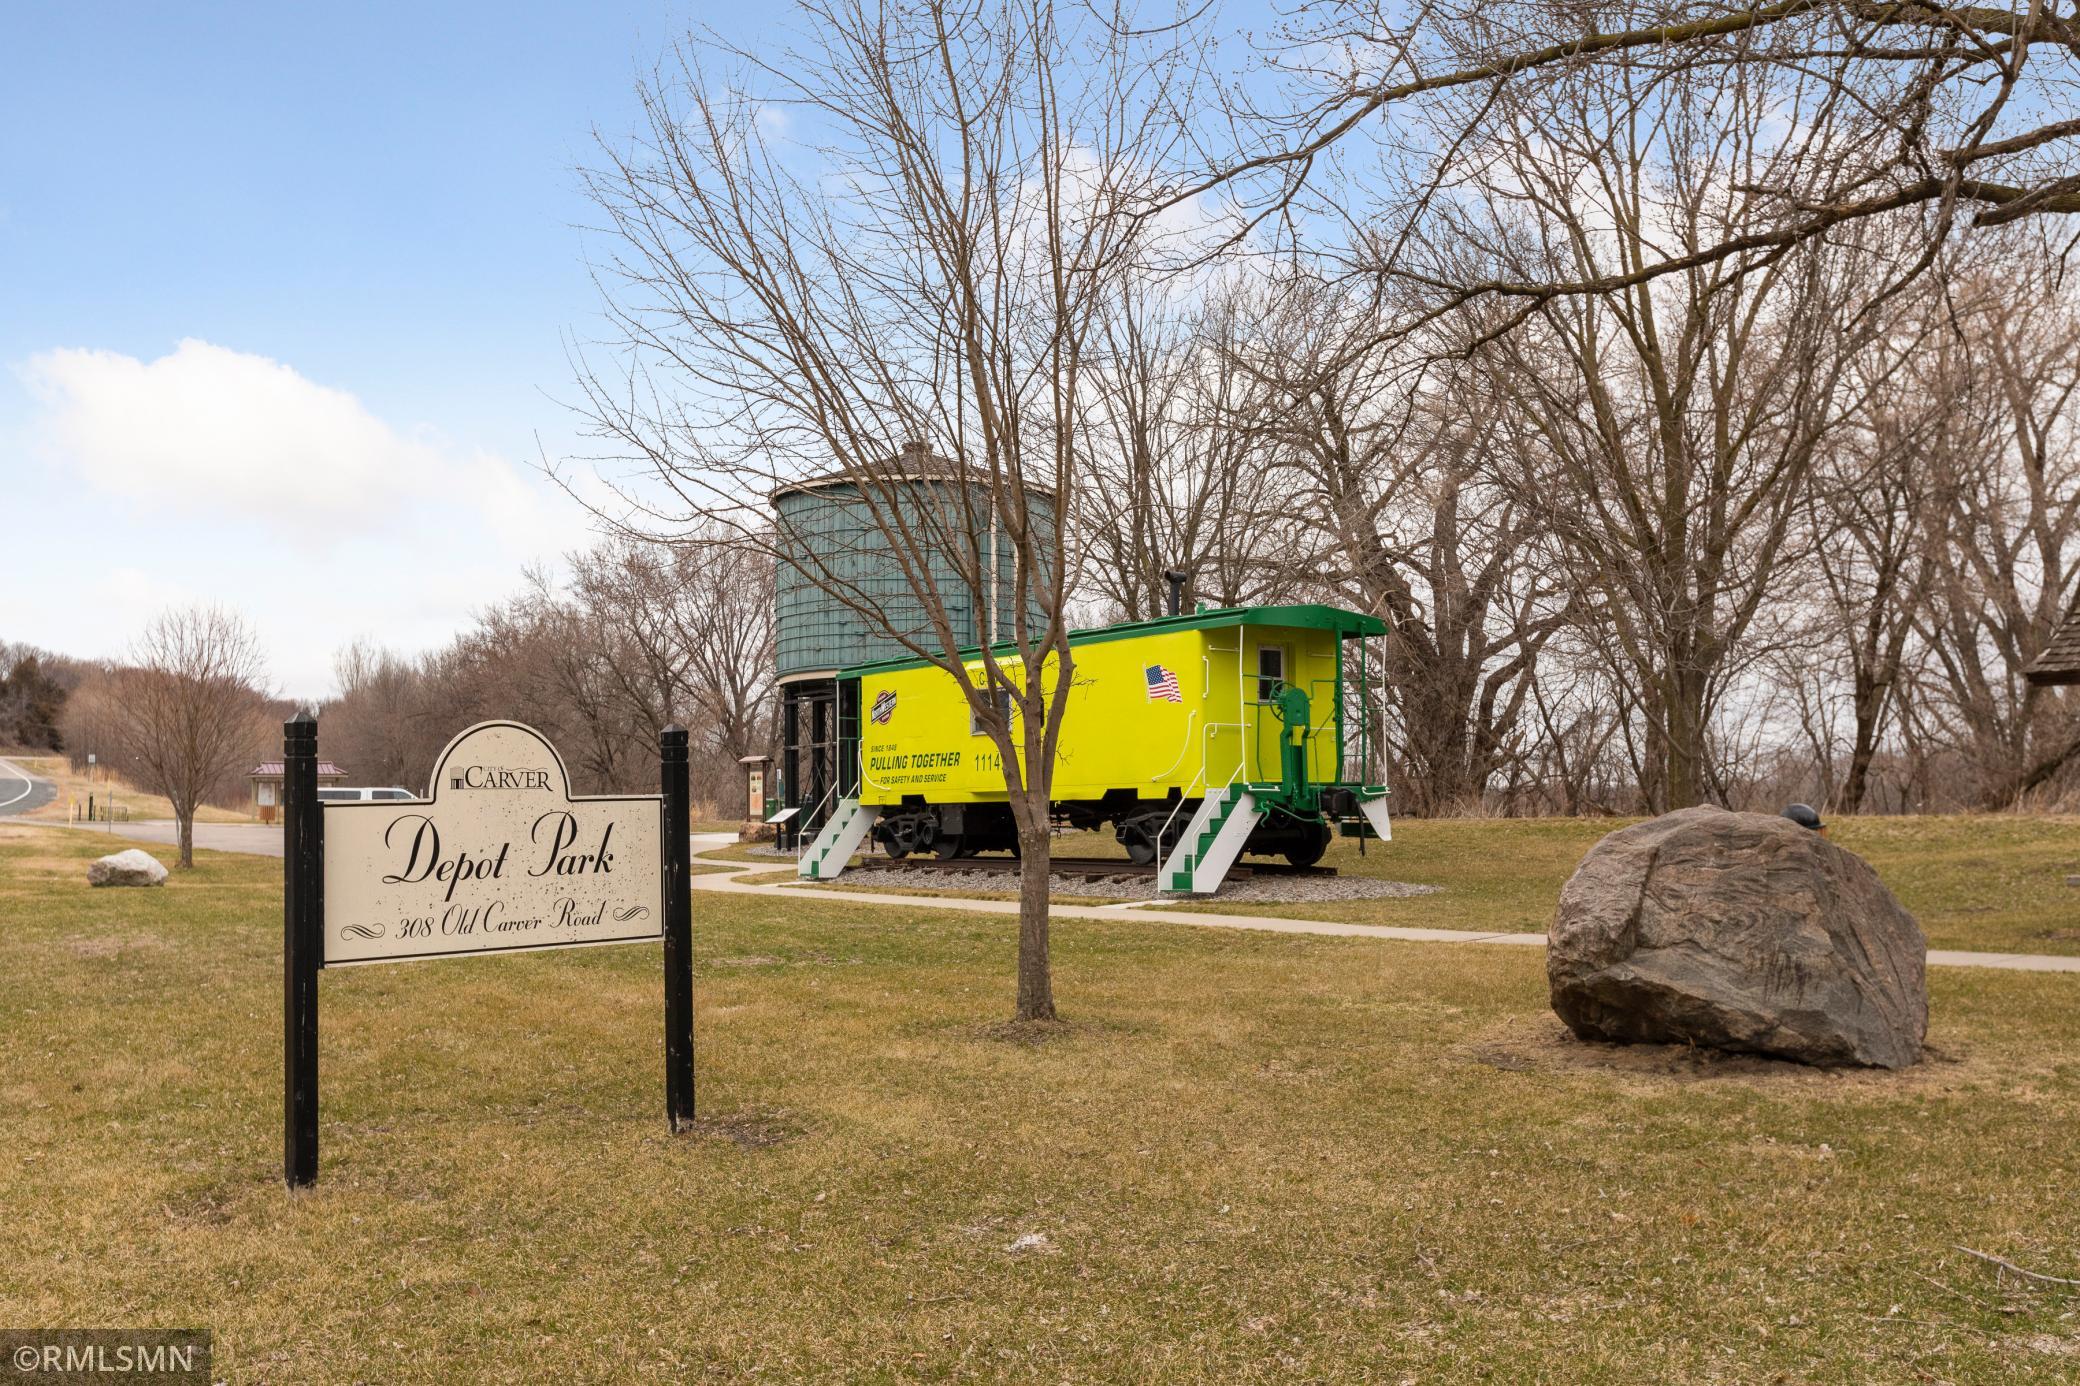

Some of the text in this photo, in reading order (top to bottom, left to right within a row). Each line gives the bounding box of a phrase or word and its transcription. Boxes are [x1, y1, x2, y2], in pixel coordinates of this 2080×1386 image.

[870, 752, 960, 771] PULLING TOGETHER
[975, 753, 1003, 772] 1114
[465, 765, 554, 792] CARVER
[891, 776, 910, 784] SAFETY
[911, 775, 922, 783] AND
[924, 774, 946, 783] SERVICE
[382, 811, 615, 902] Depot Park
[395, 897, 606, 940] 308 Old Carver Road
